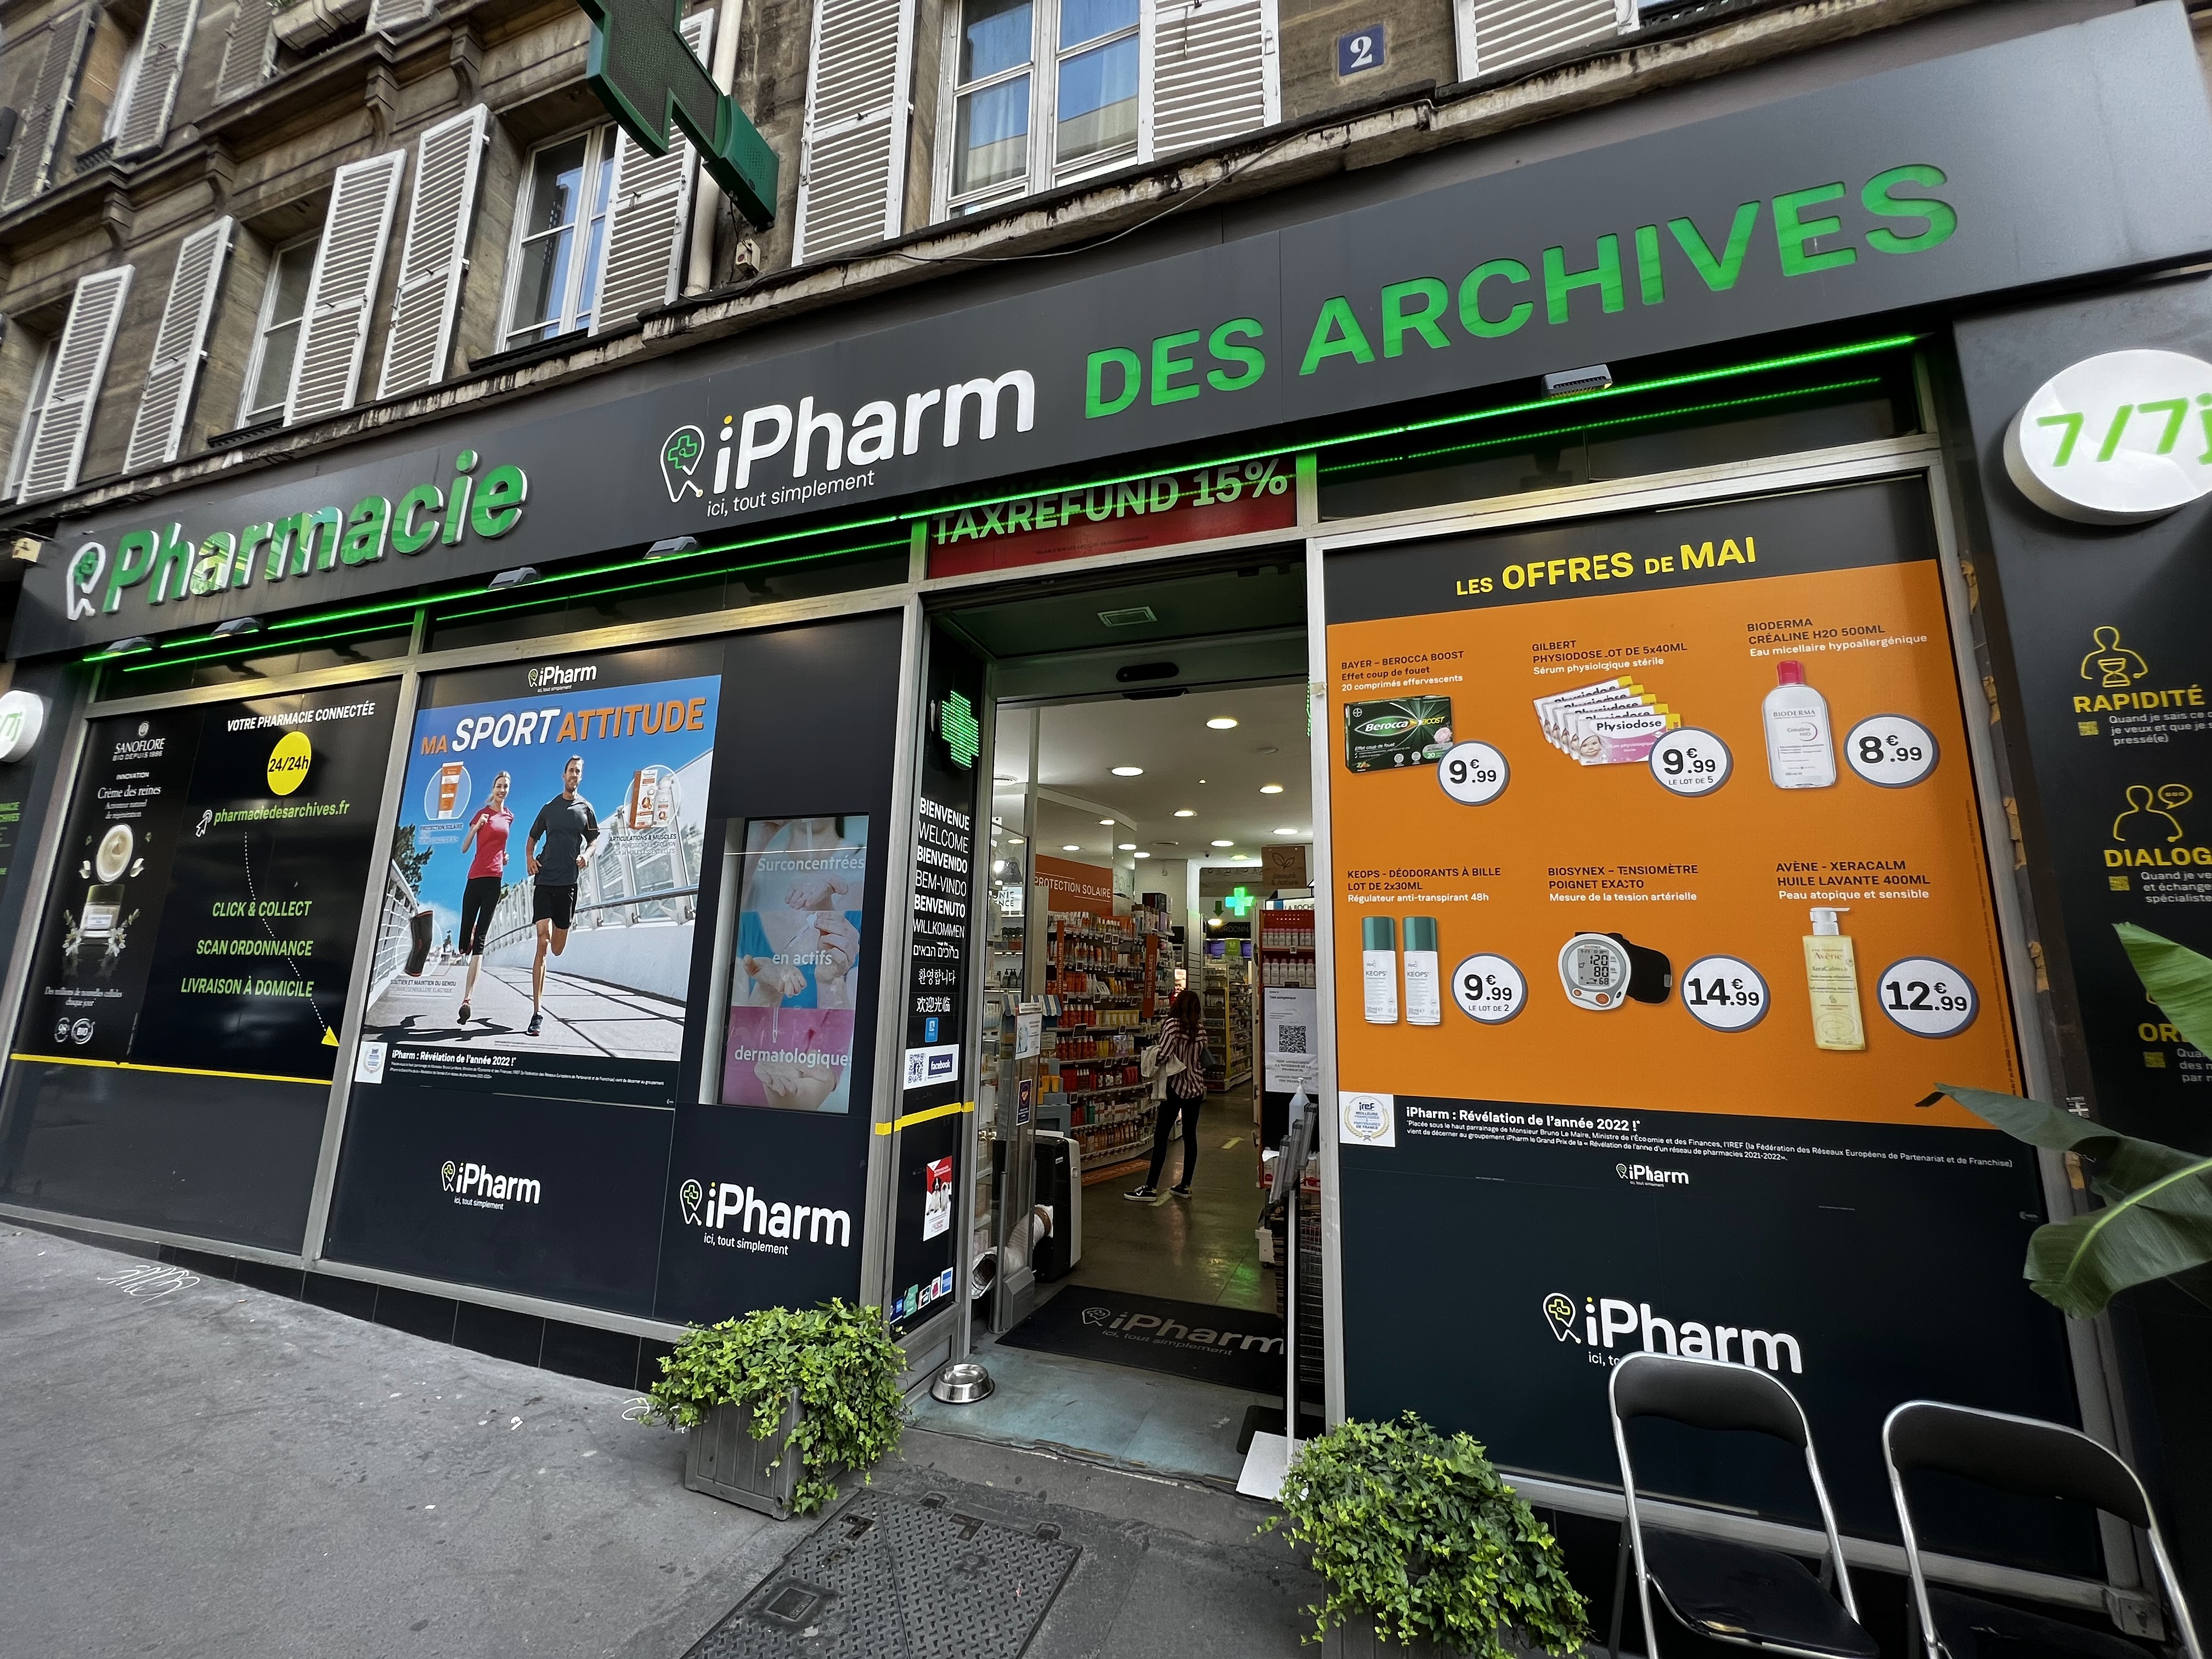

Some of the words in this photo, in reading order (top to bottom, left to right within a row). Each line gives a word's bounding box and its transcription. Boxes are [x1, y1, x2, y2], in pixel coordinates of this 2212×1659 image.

[1350, 36, 1372, 68] 2
[1085, 317, 1266, 419] DES
[1299, 163, 1958, 376] ARCHIVES
[713, 369, 1036, 494] iPharm
[733, 492, 766, 512] tout
[771, 470, 876, 505] simplement
[933, 478, 1179, 545] TAXREFUND
[1192, 458, 1288, 507] 15%
[103, 449, 528, 613] Pharmacie
[1456, 577, 1493, 596] LES
[1502, 551, 1634, 590] OFFRES
[1644, 556, 1675, 575] DE
[1680, 536, 1757, 570] MAI
[1747, 618, 1813, 632] BIODERMA
[1748, 630, 1810, 645] CRÉALINE
[1813, 629, 1838, 640] H2O
[1841, 624, 1886, 636] 500ML
[1532, 640, 1577, 652] GILBERT
[1532, 650, 1602, 664] PHYSIODOSE
[1626, 647, 1640, 656] DE
[1643, 642, 1688, 654] 5x40ML
[1750, 648, 1770, 657] Eau
[1773, 642, 1826, 654] micellaire
[1829, 634, 1928, 651] hypoallergénique
[1341, 660, 1372, 670] BAYER
[1382, 654, 1429, 666] BEROCCA
[1430, 651, 1464, 661] BOOST
[1533, 664, 1565, 675] Sérum
[1632, 657, 1664, 667] stérile
[538, 664, 597, 687] iPharm
[1341, 673, 1364, 681] Effet
[1404, 666, 1430, 675] fouet
[1354, 680, 1401, 691] comprimés
[1403, 674, 1464, 686] effervescents
[2073, 684, 2205, 713] RAPIDITÉ
[227, 718, 256, 732] VOTRE
[257, 710, 315, 728] PHARMACIE
[315, 701, 376, 721] CONNECTÉE
[1596, 719, 1662, 731] Physiodose
[2109, 714, 2147, 724] Quand
[2163, 712, 2187, 720] sais
[420, 736, 448, 755] MA
[452, 708, 561, 753] SPORT
[556, 697, 707, 743] ATTITUDE
[1365, 720, 1409, 732] Berocca
[2124, 725, 2152, 733] veux
[114, 738, 166, 754] SANOFLORE
[2113, 733, 2169, 747] pressé(e)
[125, 752, 148, 760] DEPUIS
[268, 755, 309, 772] 24/24h
[116, 771, 150, 780] INNOVATION
[213, 799, 351, 826] pharmaciedesarchives.fr
[919, 797, 970, 832] BIENVENUE
[918, 821, 969, 854] WELCOME
[757, 854, 865, 872] Surconcentrées
[917, 845, 968, 874] BIENVENIDO
[1776, 861, 1819, 872] AVÈNE
[1830, 861, 1906, 871] XERACALM
[1347, 871, 1380, 879] KEOPS
[1389, 868, 1459, 878] DÉODORANTS
[1472, 867, 1502, 876] BILLE
[1548, 867, 1605, 876] BIOSYNEX
[1617, 864, 1699, 875] TENSIOMÈTRE
[2141, 871, 2180, 881] Quand
[915, 869, 967, 897] BEM-VINDO
[1035, 876, 1081, 894] PROTECTION
[1082, 884, 1111, 899] SOLAIRE
[1369, 882, 1381, 890] DE
[1384, 882, 1423, 890] 2x30ML
[1549, 880, 1598, 889] POIGNET
[1778, 876, 1815, 887] HUILE
[1819, 876, 1880, 886] LAVANTE
[1883, 874, 1931, 885] 400ML
[1348, 894, 1395, 905] Régulateur
[1397, 893, 1469, 903] anti-transpirant
[1471, 893, 1489, 901] 48h
[1549, 893, 1586, 901] Mesure
[1651, 892, 1697, 901] artérielle
[1779, 890, 1807, 900] Peau
[1810, 889, 1861, 901] atopique
[1864, 890, 1876, 899] et
[1879, 889, 1929, 899] sensible
[212, 901, 247, 917] CLICK
[258, 900, 313, 917] COLLECT
[914, 894, 966, 918] BENVENUTO
[913, 918, 965, 939] WILLKOMMEN
[196, 940, 229, 955] SCAN
[229, 940, 314, 956] ORDONNANCE
[1814, 951, 1843, 960] Avène
[772, 953, 789, 966] en
[793, 950, 833, 967] actifs
[1590, 955, 1608, 966] 120
[918, 968, 956, 986] 환영합니다
[1594, 966, 1609, 978] 80
[180, 977, 242, 995] LIVRAISON
[255, 979, 314, 997] DOMICILE
[916, 996, 951, 1013] 欢迎光临
[392, 1049, 415, 1060] iPharm
[420, 1051, 455, 1063] Révélation
[492, 1056, 510, 1066] 2022
[930, 1059, 951, 1071] facebook
[1406, 1107, 1449, 1120] iPharm
[1459, 1109, 1525, 1125] Révélation
[1527, 1114, 1544, 1126] de
[1547, 1115, 1594, 1130] l'année
[1597, 1118, 1629, 1132] 2022
[455, 1161, 541, 1205] iPharm
[1629, 1164, 1689, 1184] iPharm
[705, 1181, 851, 1248] iPharm
[718, 1235, 735, 1248] tout
[736, 1238, 789, 1257] simplement
[1109, 1311, 1284, 1355] iPharm
[1585, 1297, 1803, 1374] iPharm
[1152, 1338, 1233, 1356] simplement
